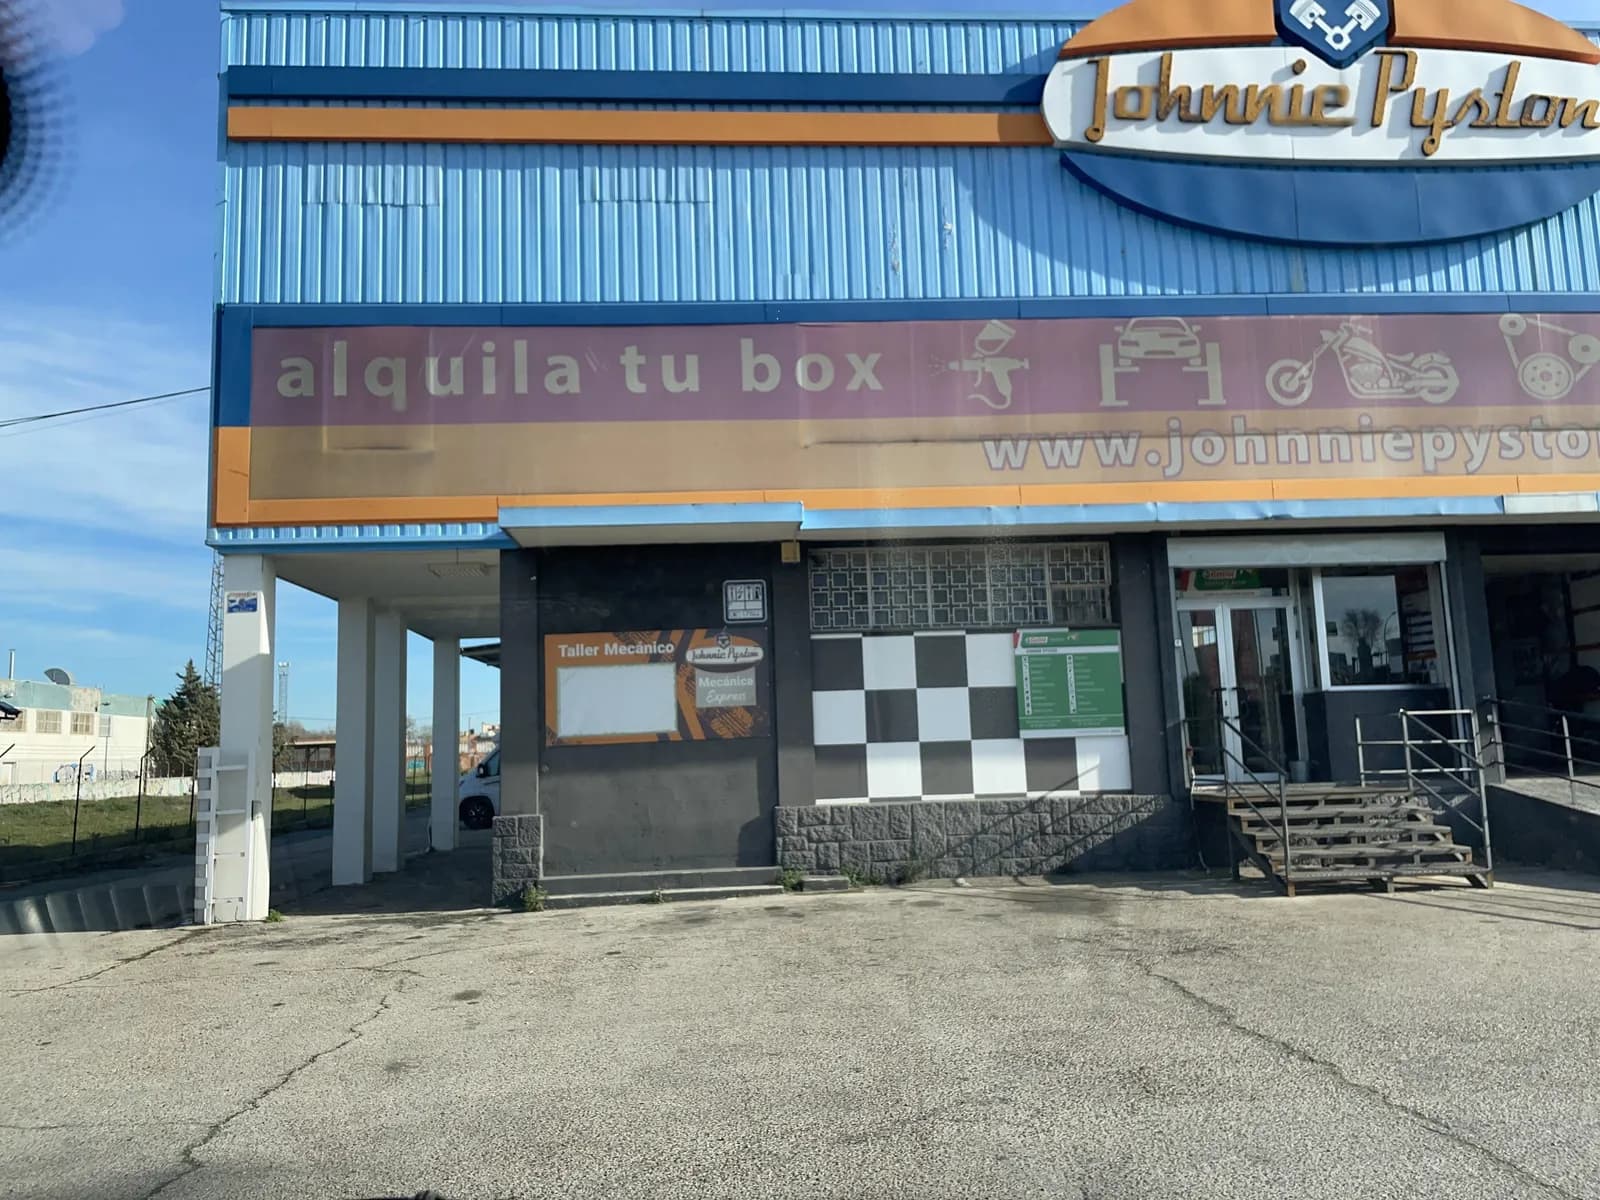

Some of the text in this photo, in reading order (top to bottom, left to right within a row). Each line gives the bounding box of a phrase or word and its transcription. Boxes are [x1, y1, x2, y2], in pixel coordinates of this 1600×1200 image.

[1086, 50, 1600, 156] Johnnie Pyston
[277, 338, 883, 412] alquila tu box
[981, 414, 1600, 478] www.johnniepysto
[558, 641, 675, 657] Taller Mecánico
